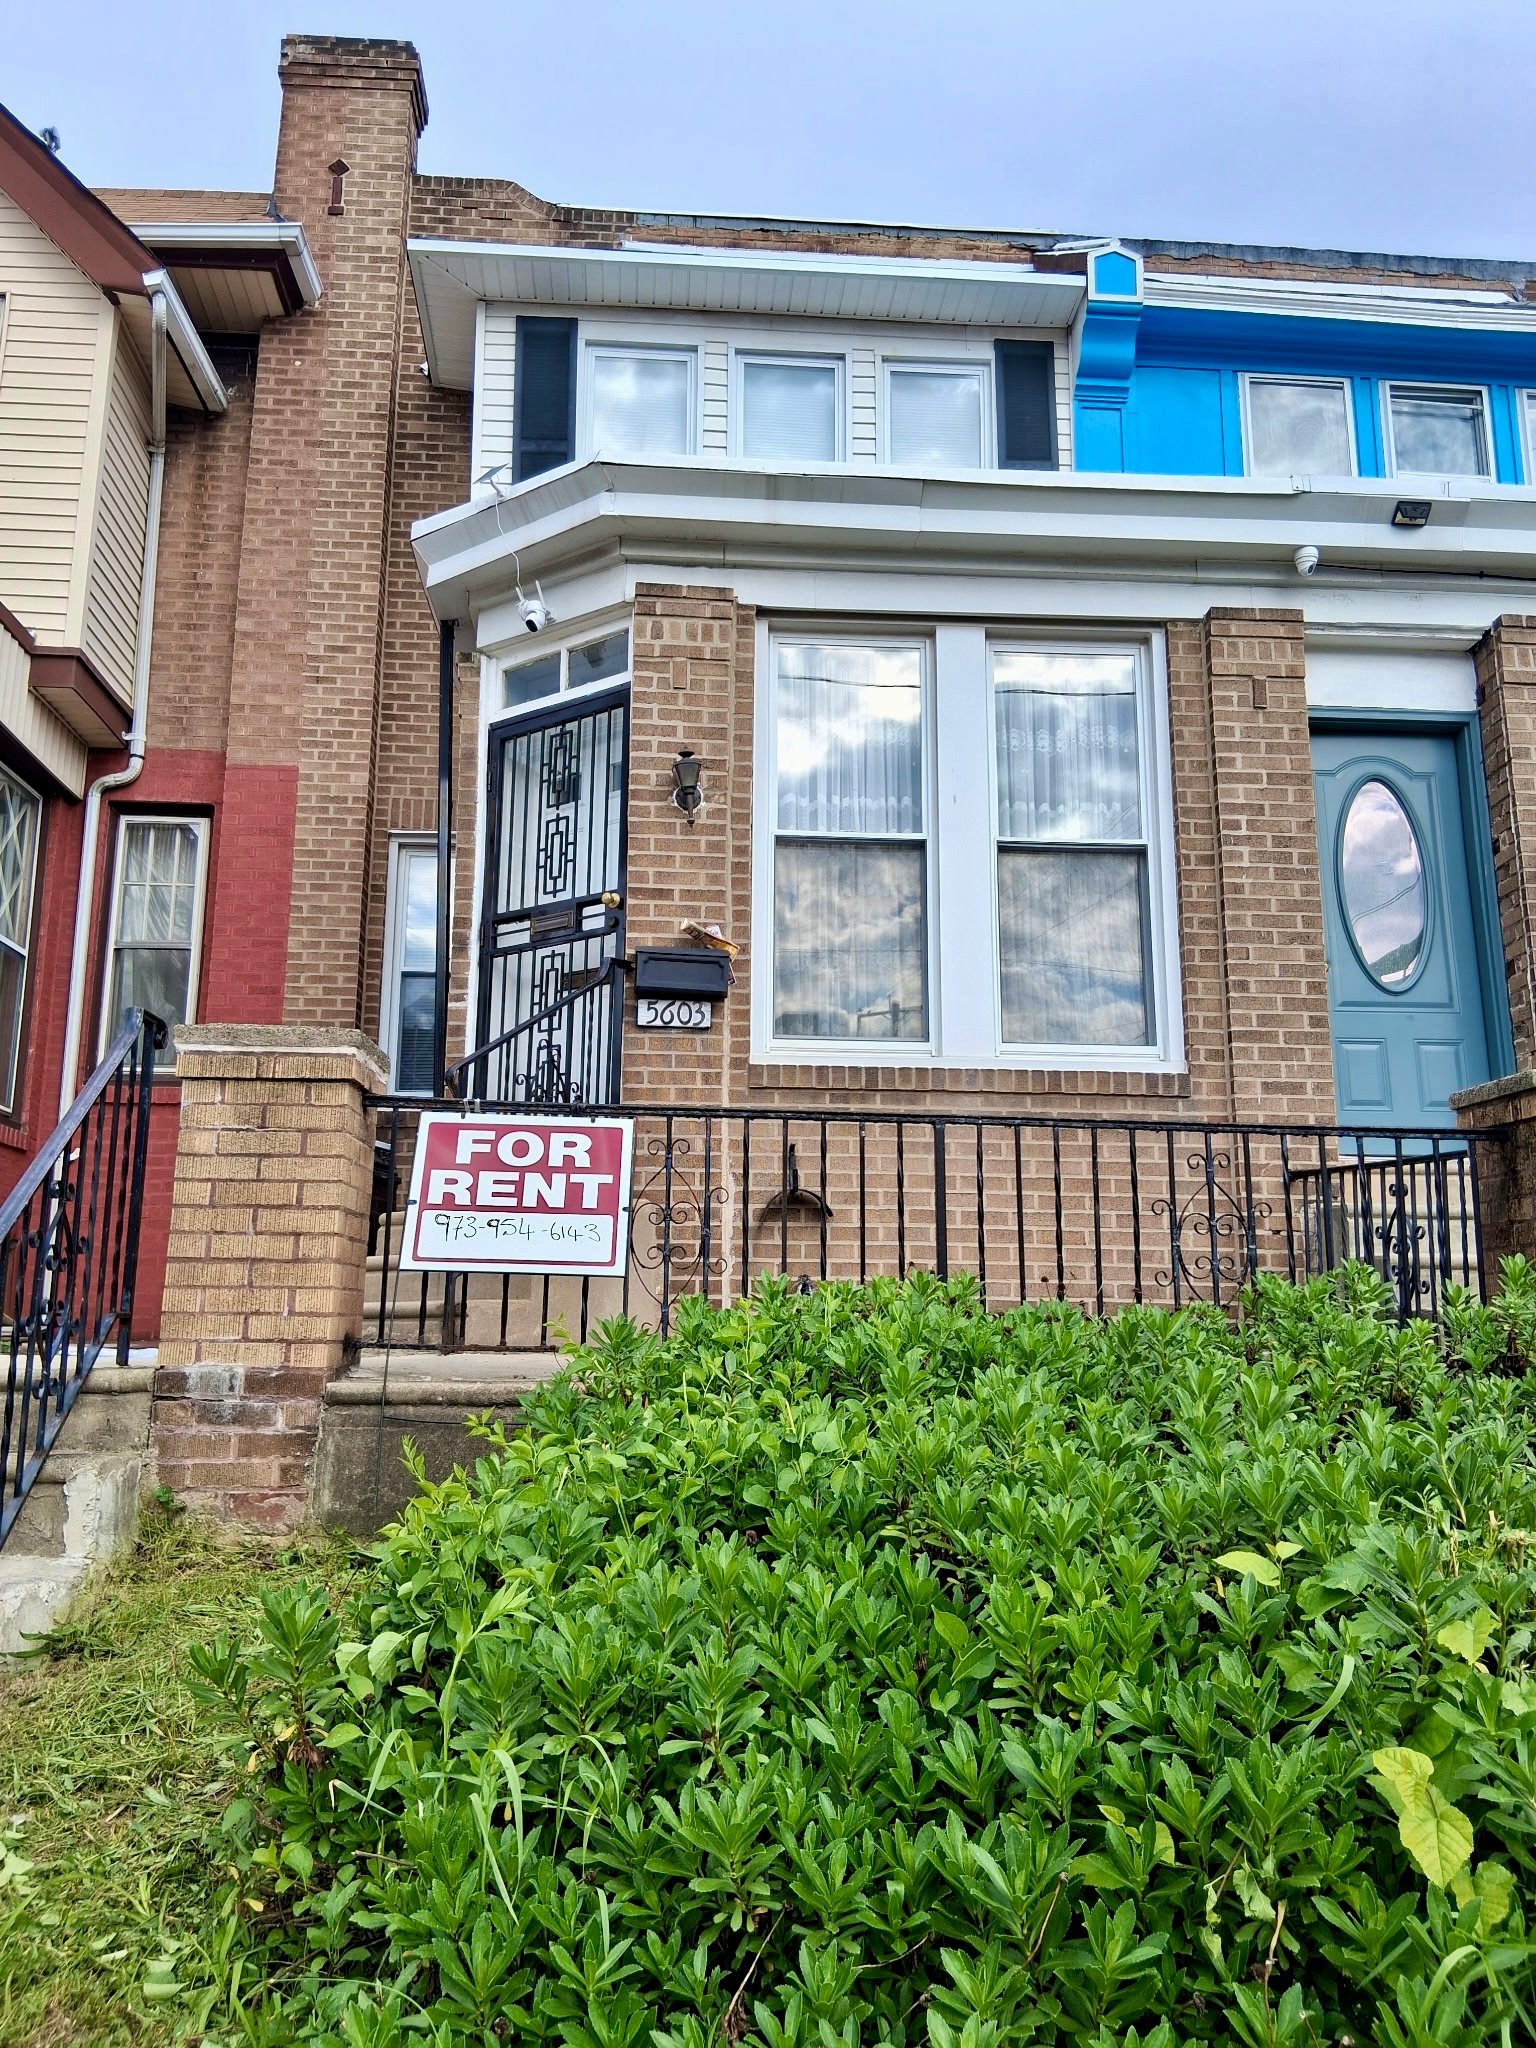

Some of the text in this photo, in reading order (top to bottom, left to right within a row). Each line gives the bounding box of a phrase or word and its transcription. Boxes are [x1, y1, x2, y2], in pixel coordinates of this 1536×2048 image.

[646, 1000, 705, 1026] 5603
[455, 1129, 592, 1168] FOR
[427, 1169, 613, 1209] RENT
[434, 1213, 600, 1242] 973-954-6143
